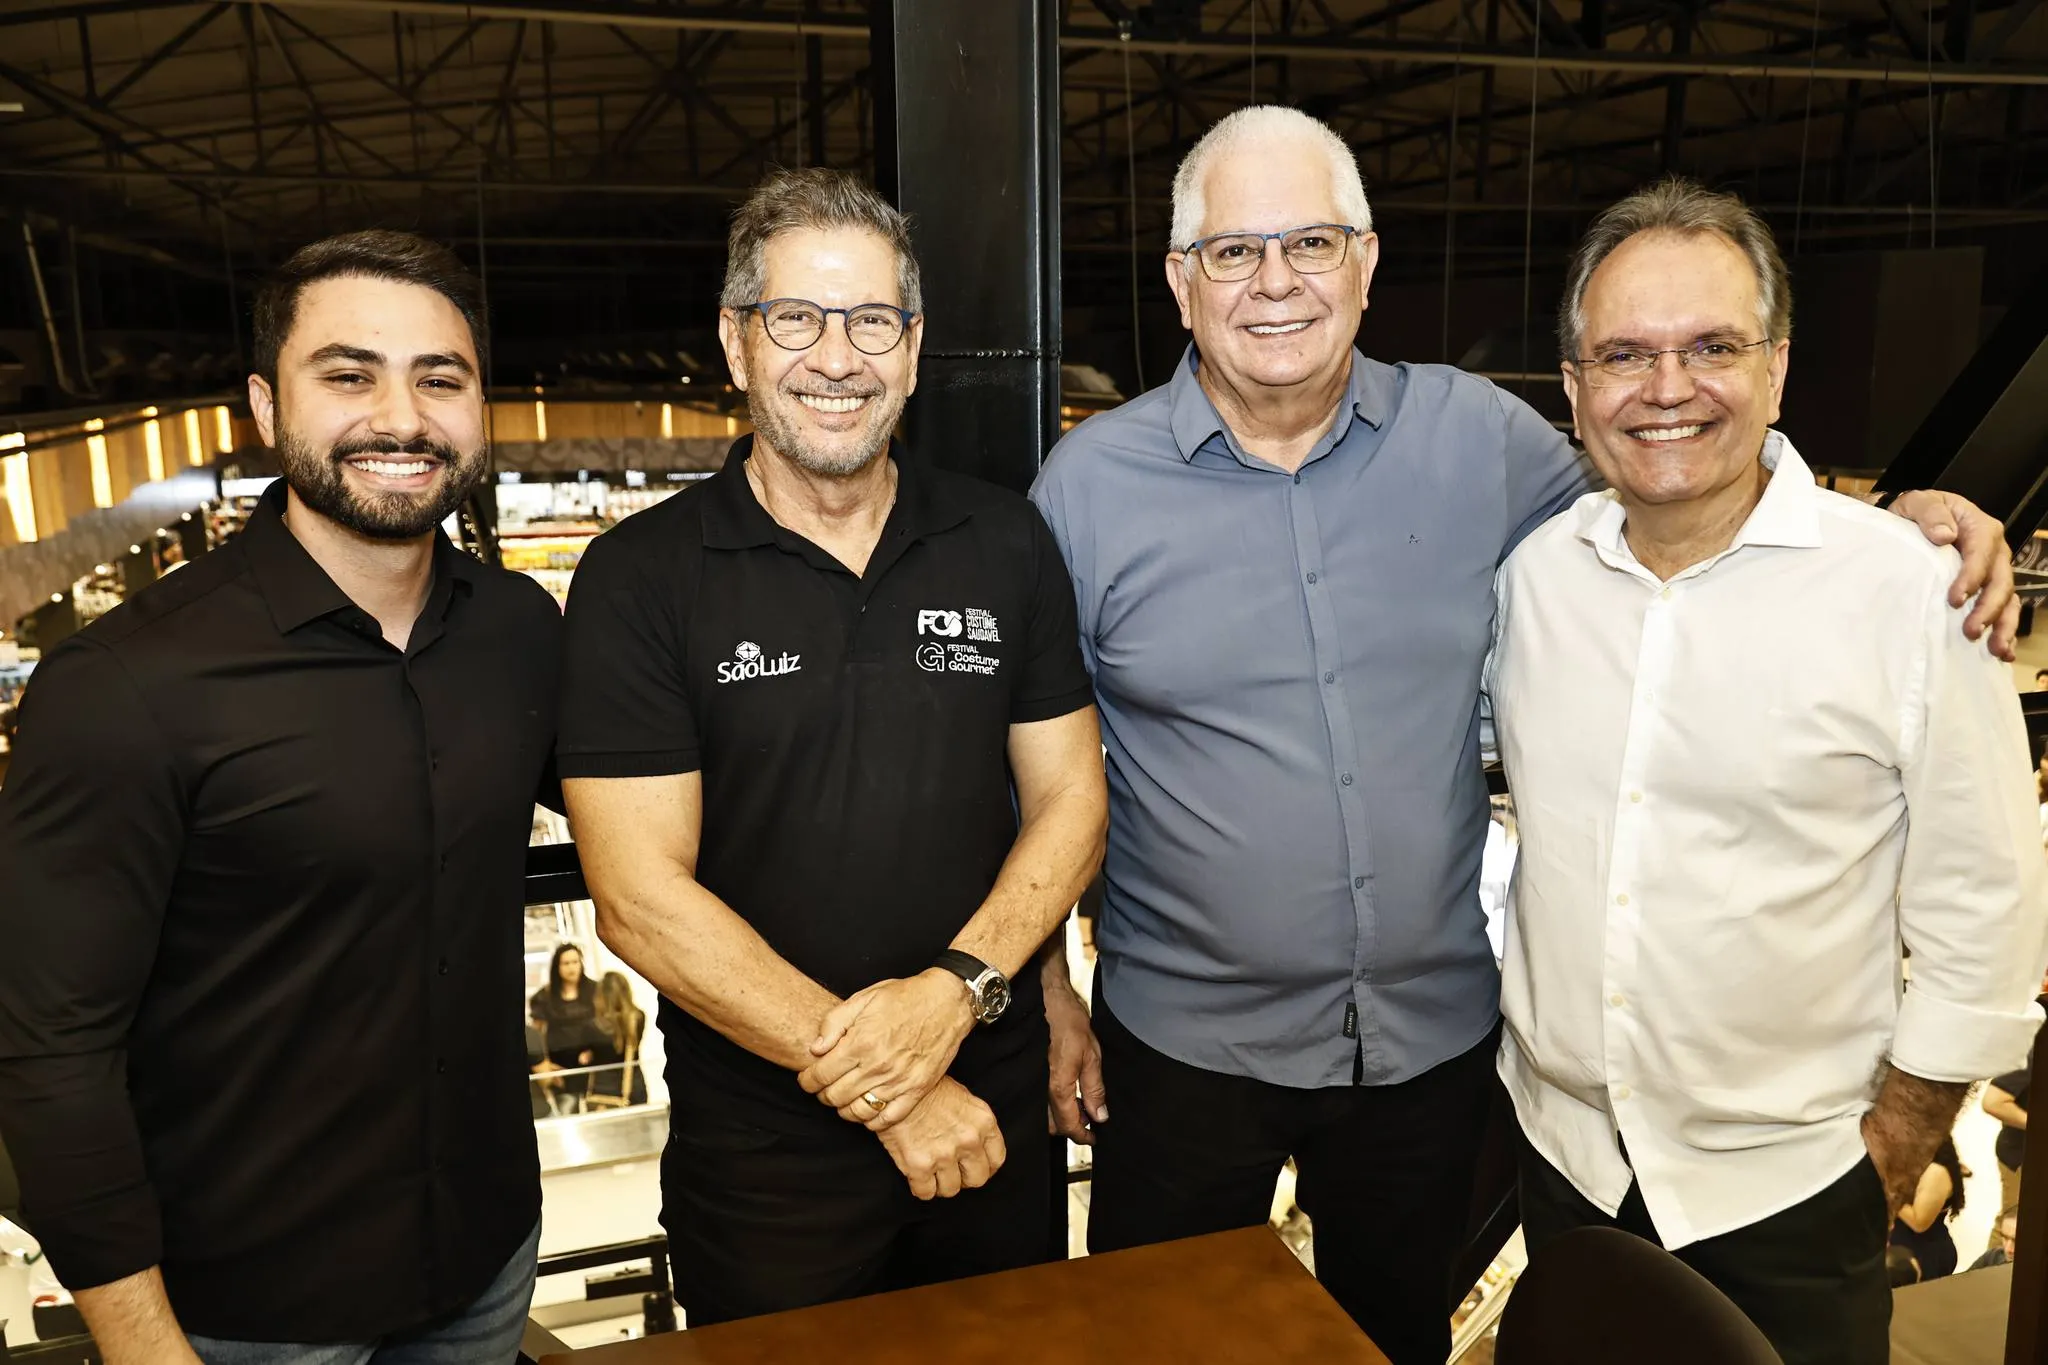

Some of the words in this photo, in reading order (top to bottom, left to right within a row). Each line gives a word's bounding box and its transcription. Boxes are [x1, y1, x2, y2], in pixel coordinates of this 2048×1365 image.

[965, 607, 992, 618] FESTIVAL
[966, 615, 998, 630] COSTUME
[947, 644, 979, 654] FESTIVAL
[954, 652, 1000, 667] Costume
[948, 660, 996, 675] Gourmet
